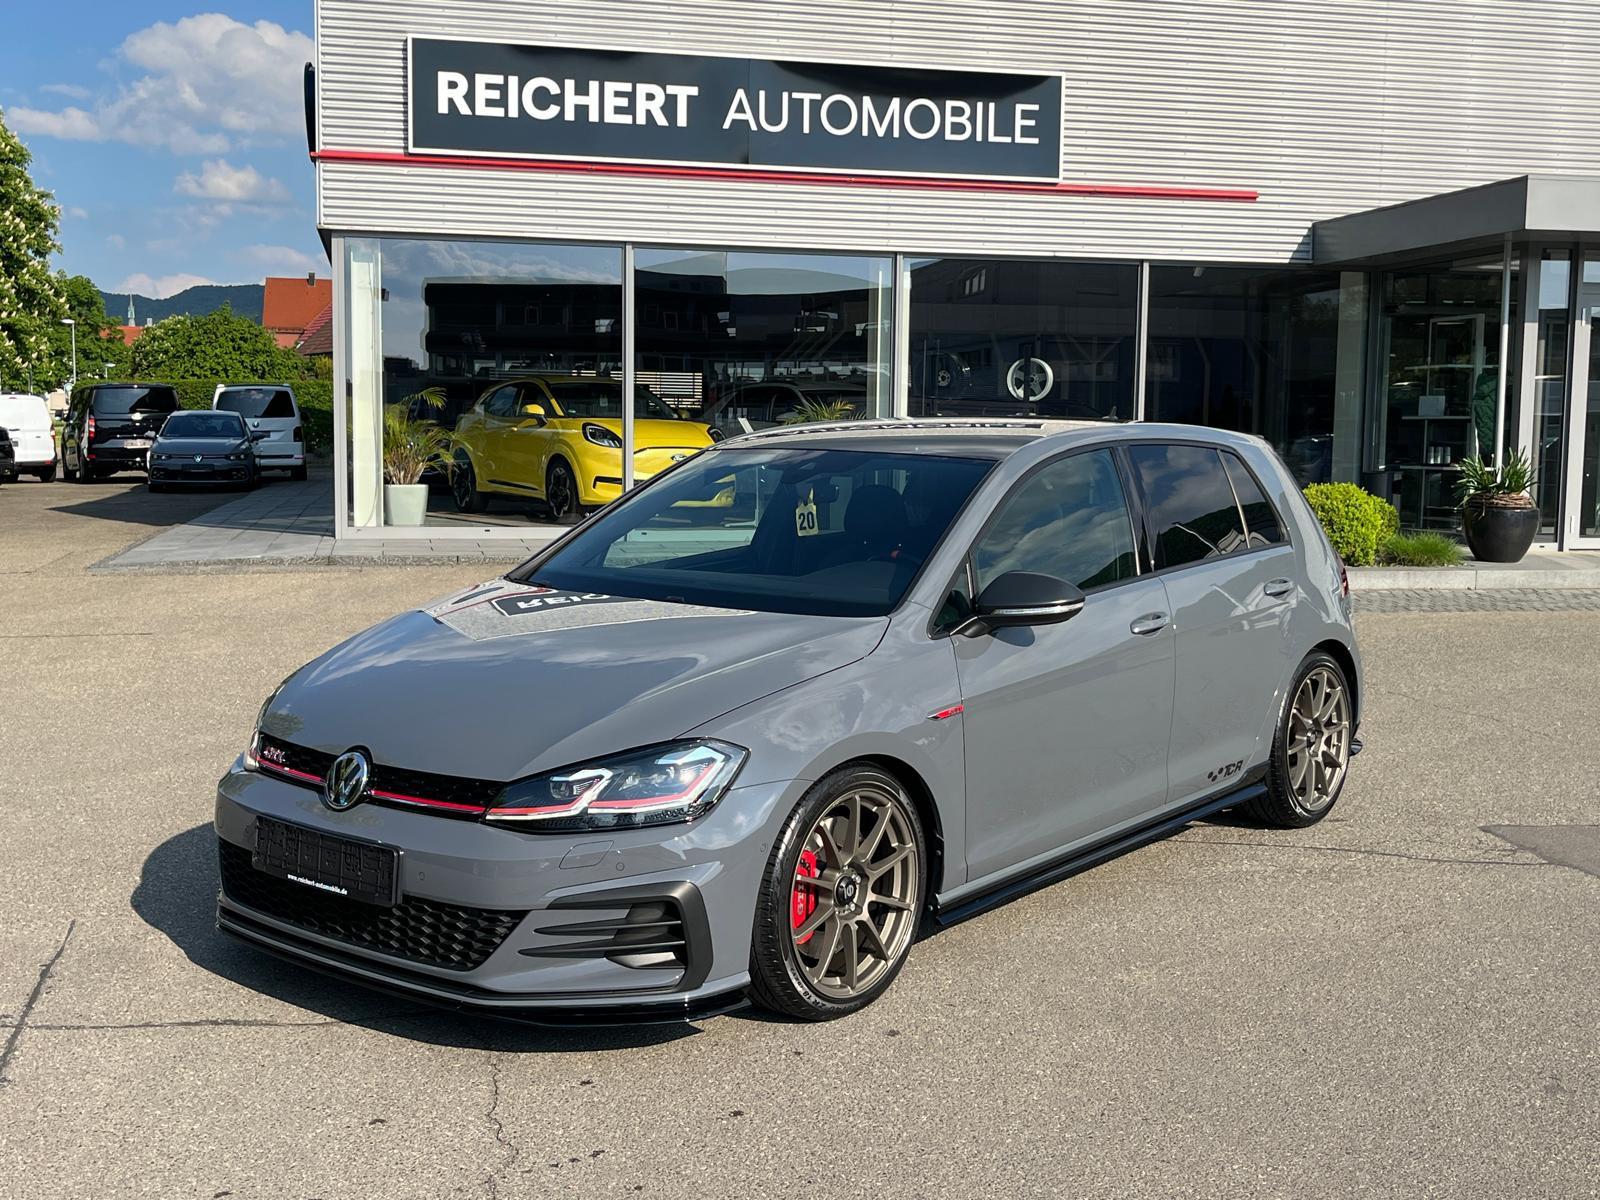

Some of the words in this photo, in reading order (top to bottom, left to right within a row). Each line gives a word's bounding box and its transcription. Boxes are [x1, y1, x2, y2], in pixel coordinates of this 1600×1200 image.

[436, 71, 699, 127] REICHERT
[722, 88, 1040, 145] AUTOMOBILE
[798, 511, 815, 531] 20
